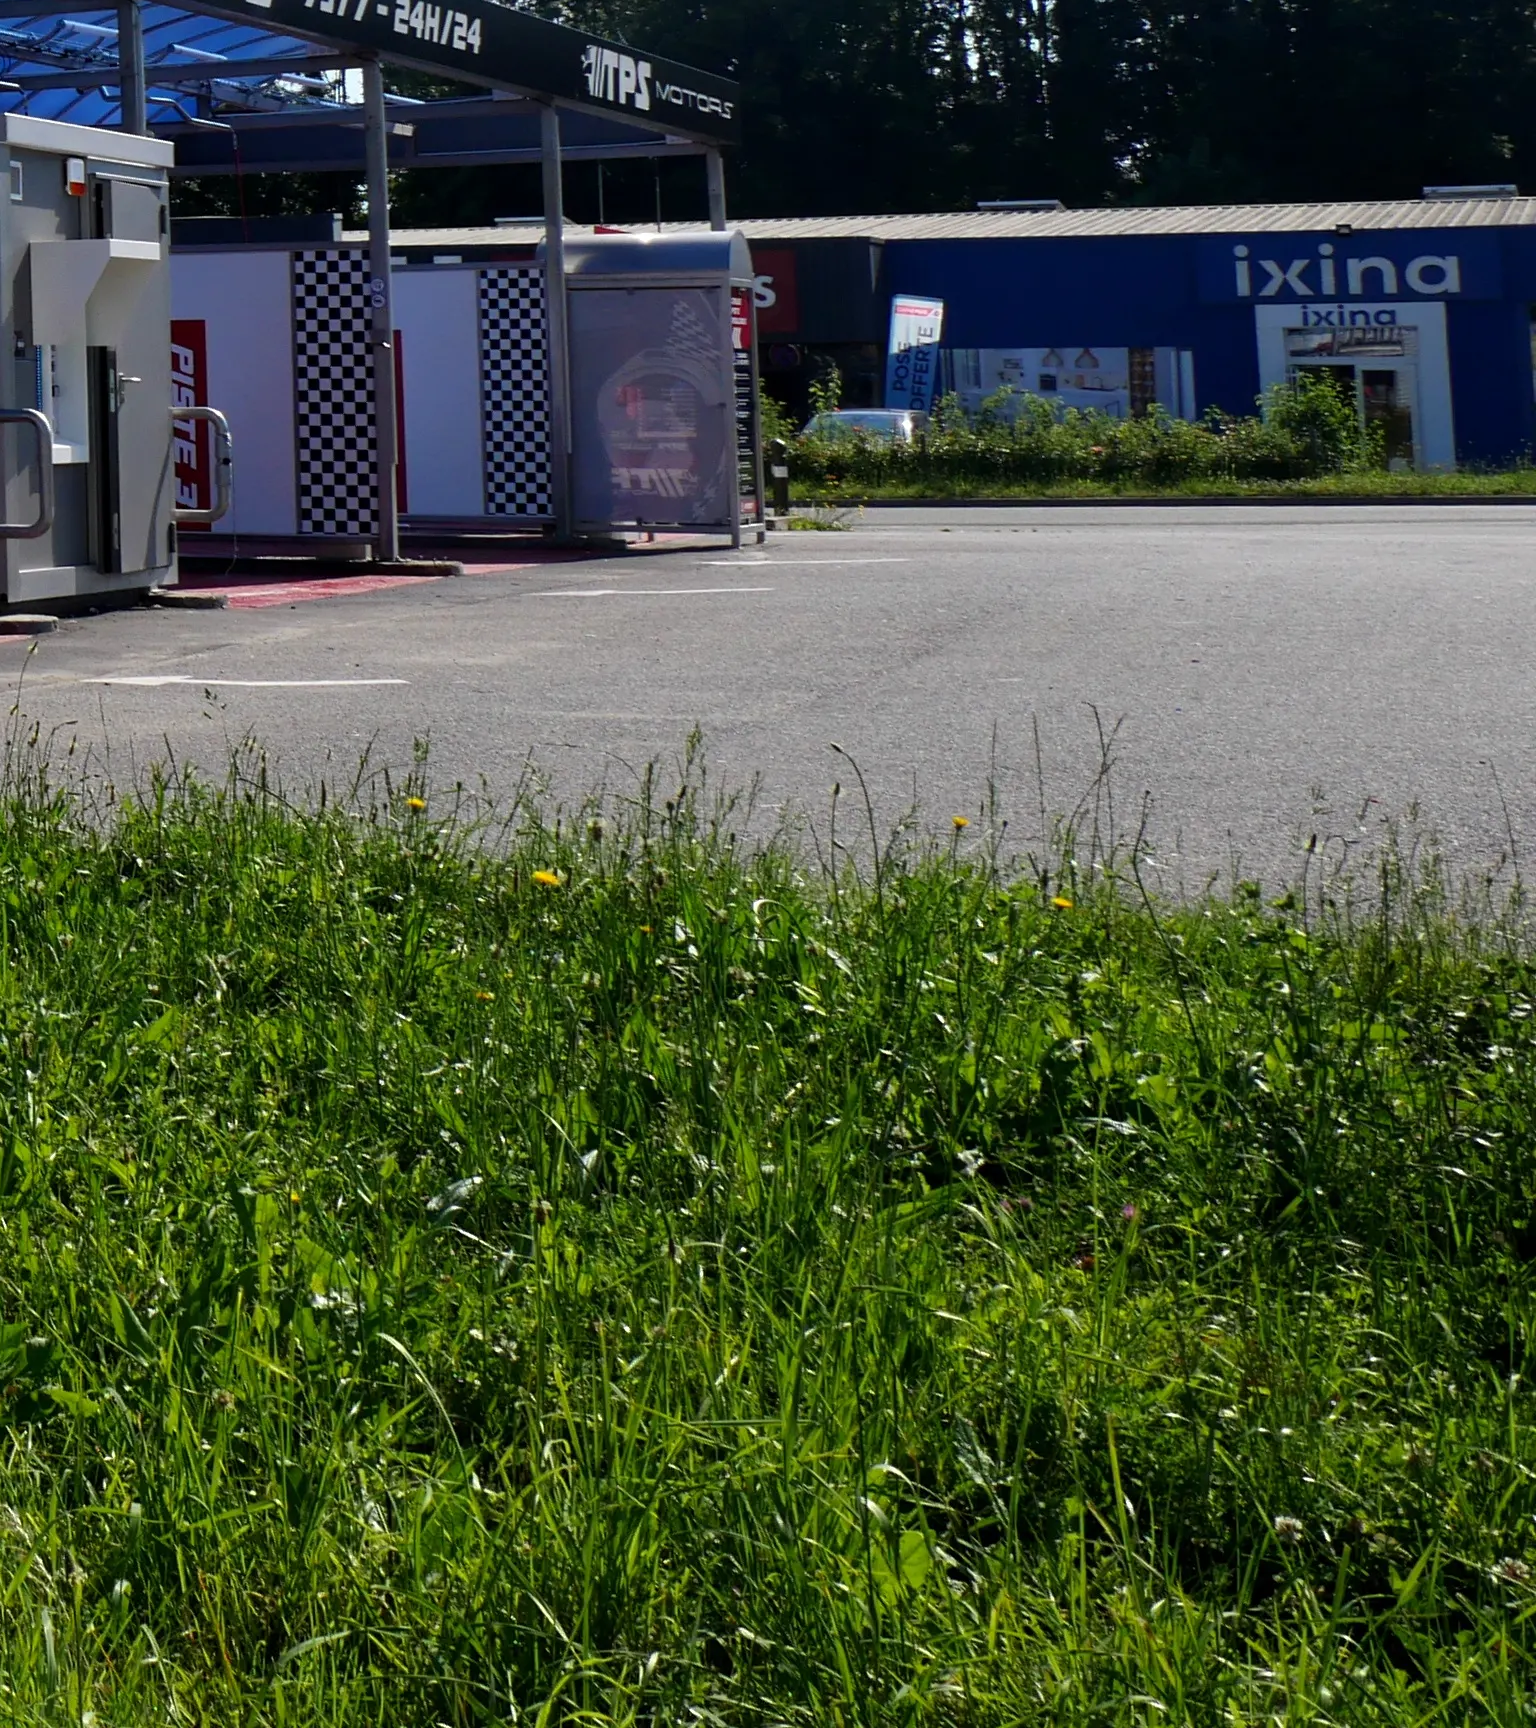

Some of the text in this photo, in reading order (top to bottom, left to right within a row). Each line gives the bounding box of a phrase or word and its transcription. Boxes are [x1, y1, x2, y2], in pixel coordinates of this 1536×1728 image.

[600, 50, 734, 120] TPS MOTORS
[1233, 243, 1461, 297] ixina
[1302, 304, 1396, 326] ixina
[893, 341, 910, 391] POSE
[910, 326, 934, 410] OFFERTE
[171, 343, 198, 508] PISTE 3
